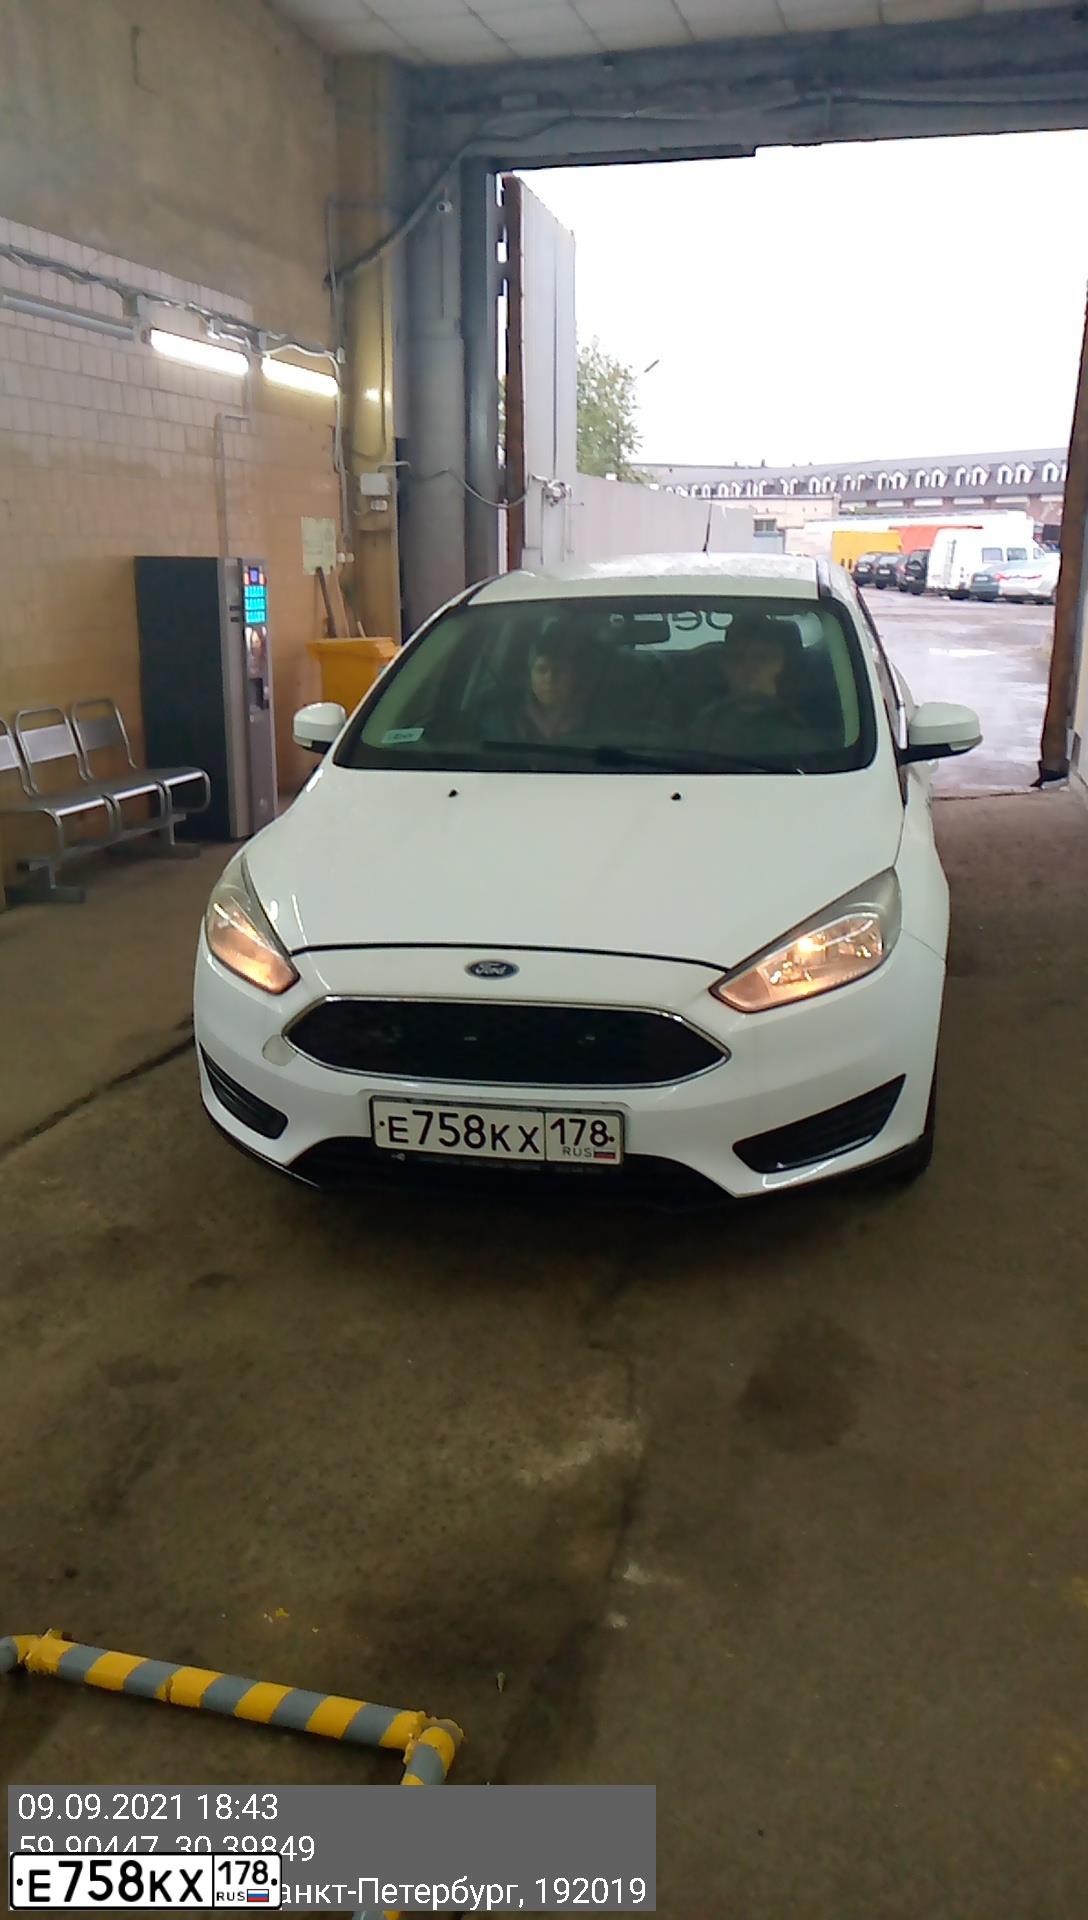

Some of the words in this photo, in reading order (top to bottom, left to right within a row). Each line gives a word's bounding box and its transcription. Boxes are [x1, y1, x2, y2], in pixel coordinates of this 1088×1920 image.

[387, 1109, 541, 1154] Е758КХ
[550, 1118, 609, 1147] 178
[562, 1147, 593, 1159] RUS
